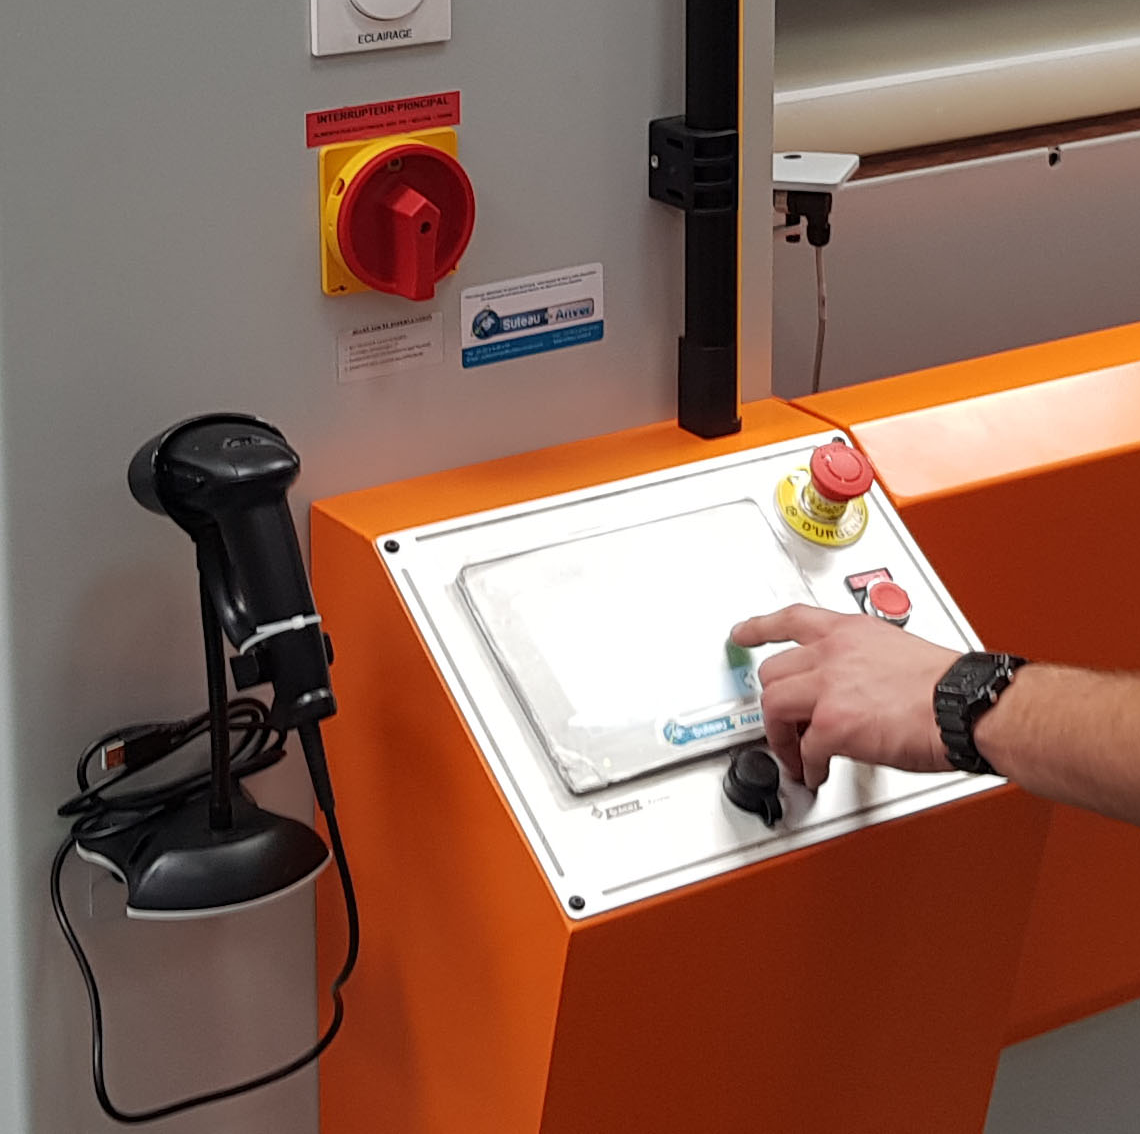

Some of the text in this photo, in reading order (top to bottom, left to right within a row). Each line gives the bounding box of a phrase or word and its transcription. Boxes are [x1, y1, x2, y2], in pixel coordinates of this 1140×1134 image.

[357, 28, 412, 44] ECLAIRAGE
[316, 104, 395, 125] INTERRUPTEUR
[397, 96, 449, 113] PRINCIPAL
[502, 305, 590, 331] Suteau Anver
